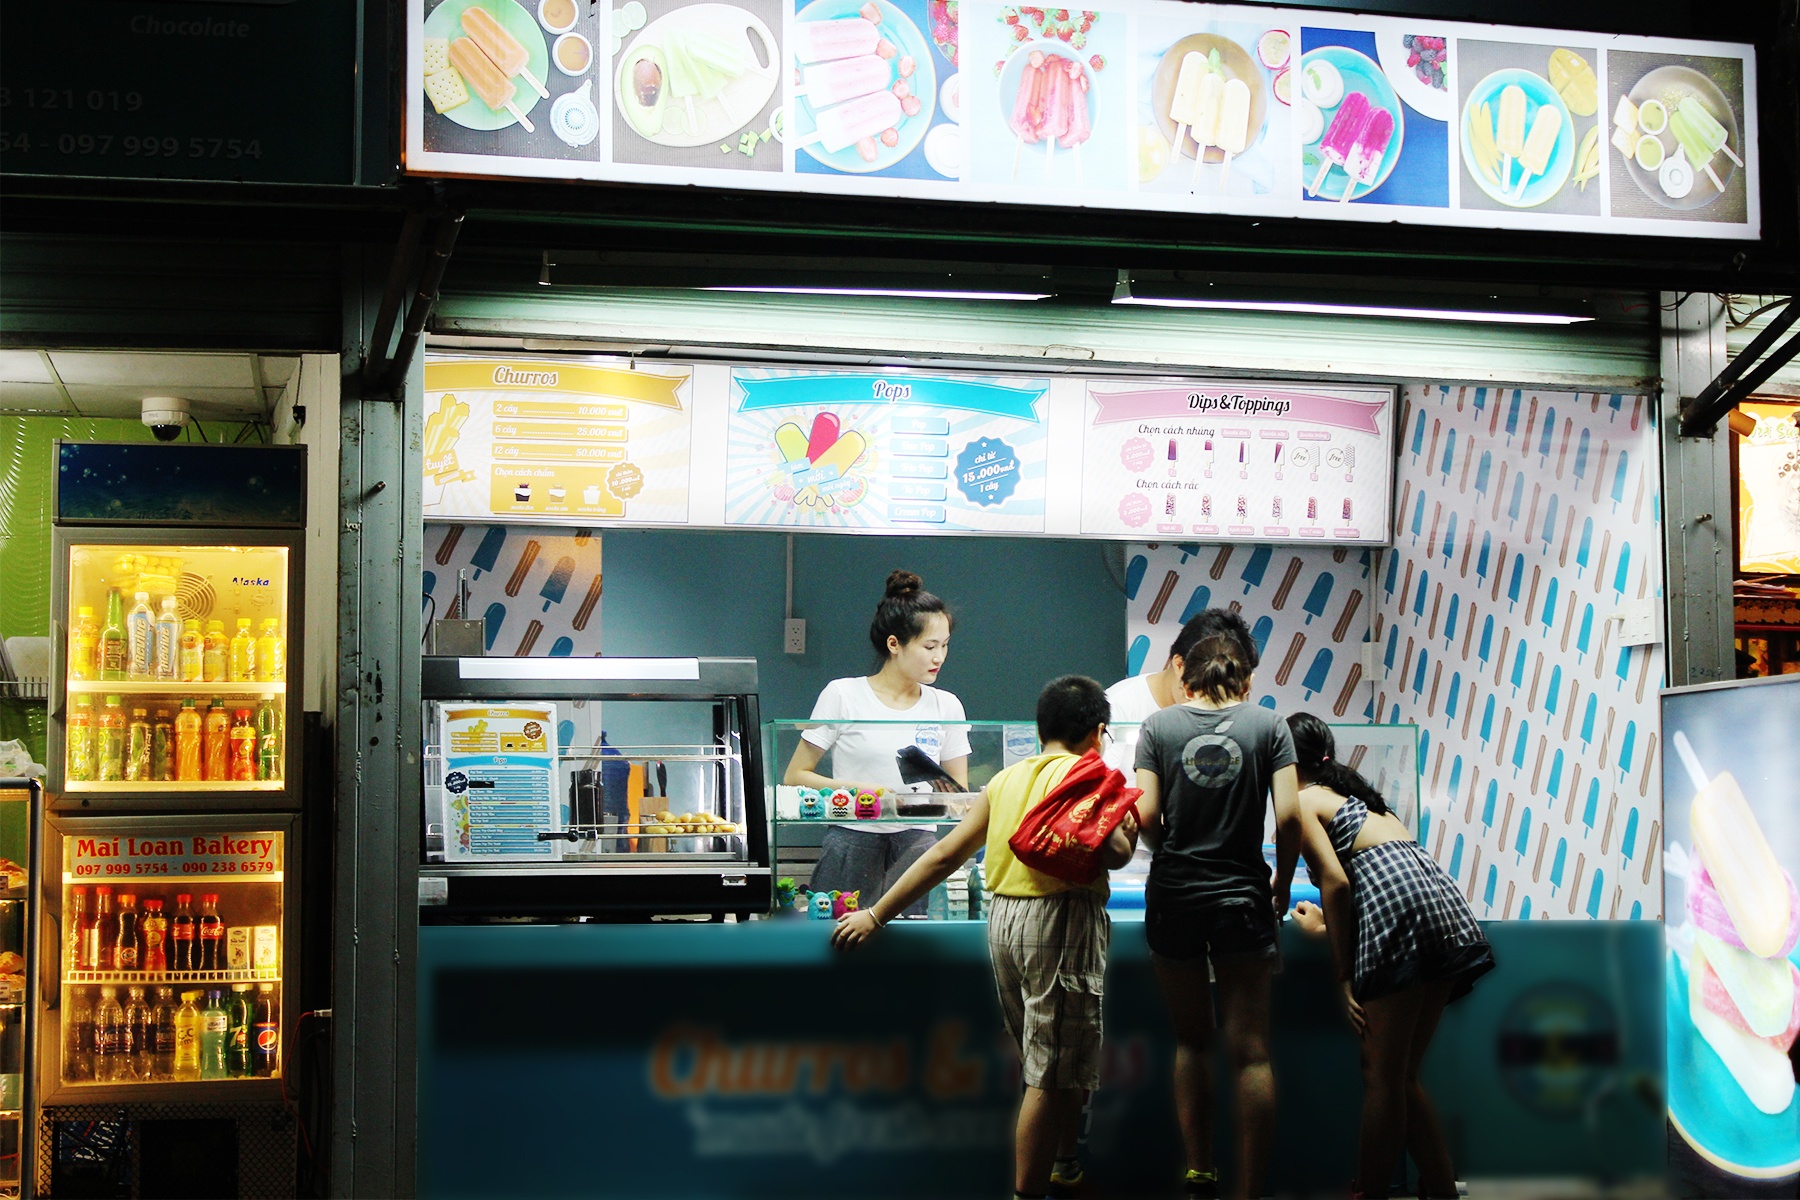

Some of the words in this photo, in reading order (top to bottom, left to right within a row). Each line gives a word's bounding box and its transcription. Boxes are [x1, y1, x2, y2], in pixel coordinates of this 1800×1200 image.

[130, 14, 250, 38] Chocolate
[23, 89, 76, 110] 121
[86, 91, 143, 112] 019
[58, 134, 114, 155] 097
[123, 135, 180, 157] 999
[188, 138, 263, 160] 5754
[493, 365, 558, 386] Churros
[873, 380, 910, 402] Pops
[496, 403, 502, 413] 2
[577, 406, 607, 416] 10.000
[576, 427, 607, 437] 25.000
[1138, 424, 1161, 437] Chọn
[1163, 425, 1184, 435] cách
[1186, 425, 1215, 438] nhúng
[493, 446, 503, 455] 12
[575, 448, 606, 458] 50.000
[1136, 478, 1158, 492] Chọn
[1160, 479, 1182, 490] cách
[894, 506, 920, 517] Cream
[920, 507, 936, 519] Pop
[232, 576, 269, 586] Alaska
[77, 837, 120, 857] Mai
[128, 837, 184, 856] Loan
[192, 835, 273, 859] Bakery
[76, 865, 101, 875] 097
[106, 863, 131, 875] 999
[135, 862, 168, 875] 5754
[182, 862, 207, 874] 090
[212, 861, 236, 873] 238
[240, 861, 274, 872] 6579
